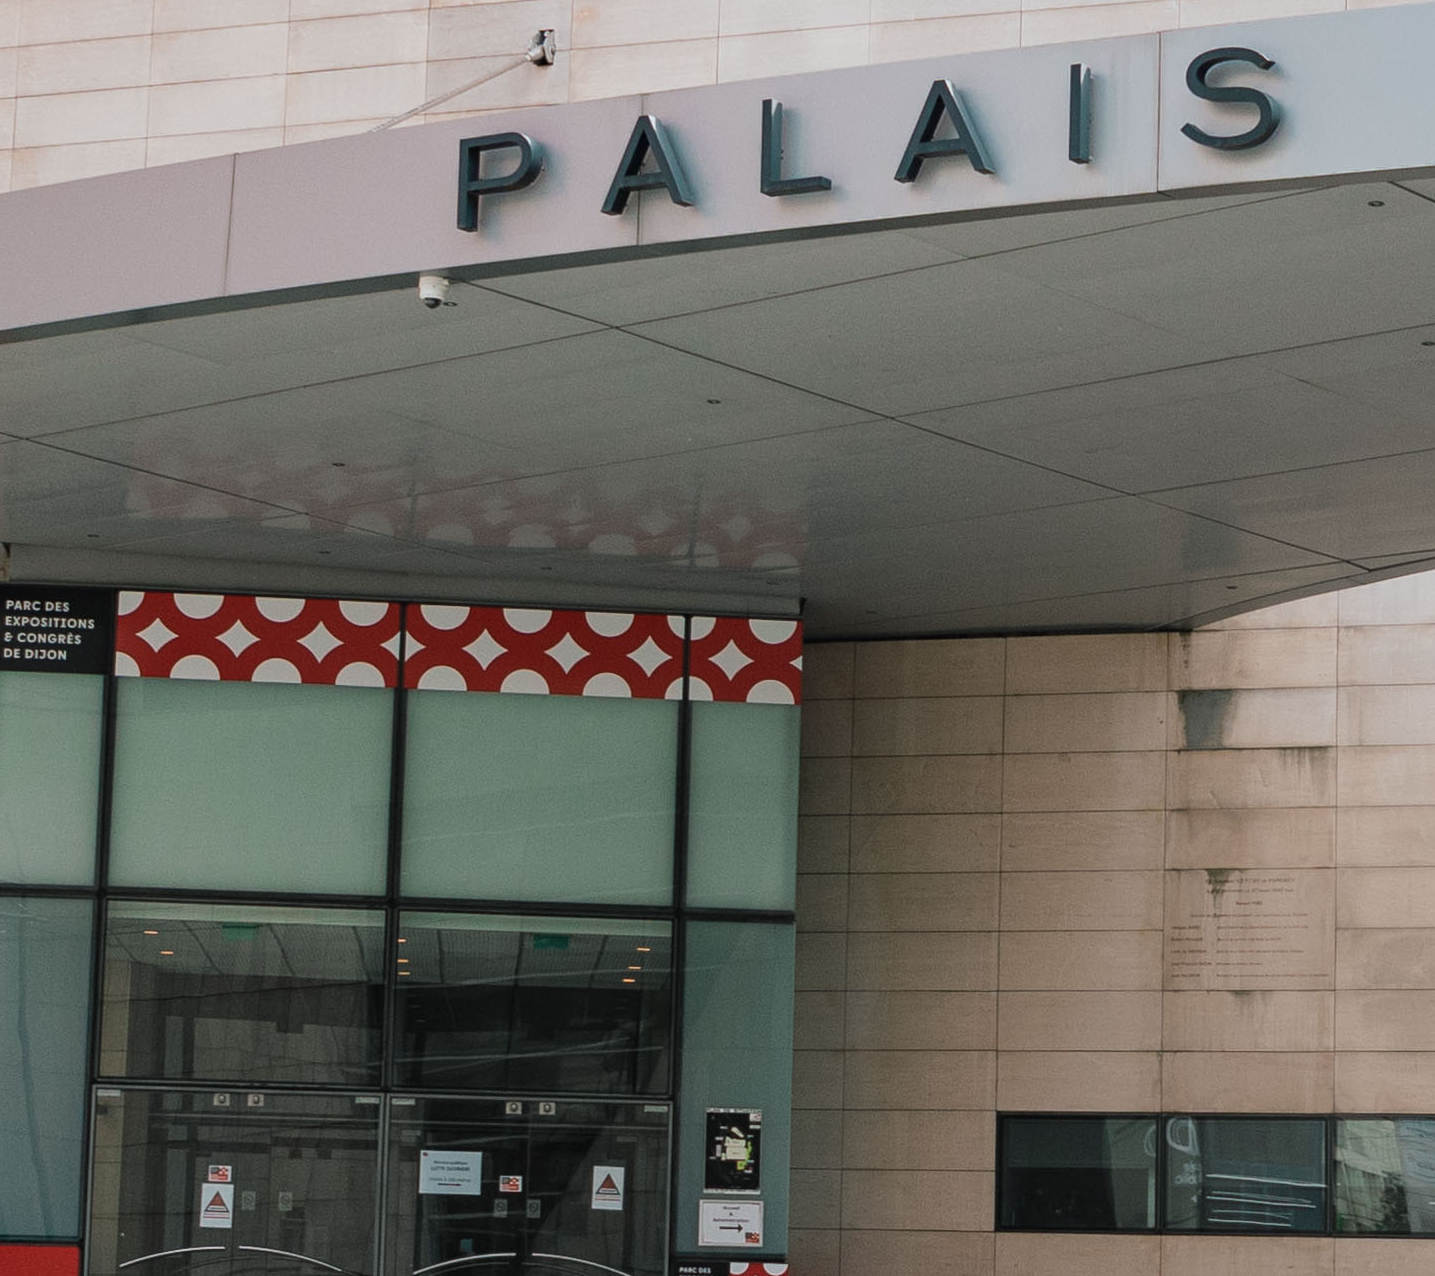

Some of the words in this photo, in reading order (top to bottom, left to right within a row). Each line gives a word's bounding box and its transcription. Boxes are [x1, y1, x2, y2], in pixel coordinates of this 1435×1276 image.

[457, 46, 1286, 233] PALAIS
[6, 600, 41, 611] PARC
[46, 601, 70, 612] DES
[5, 616, 95, 629] EXPOSITIONS
[4, 632, 13, 642] &
[17, 632, 82, 645] CONGRÈS
[4, 648, 21, 659] DE
[25, 649, 67, 660] DIJON
